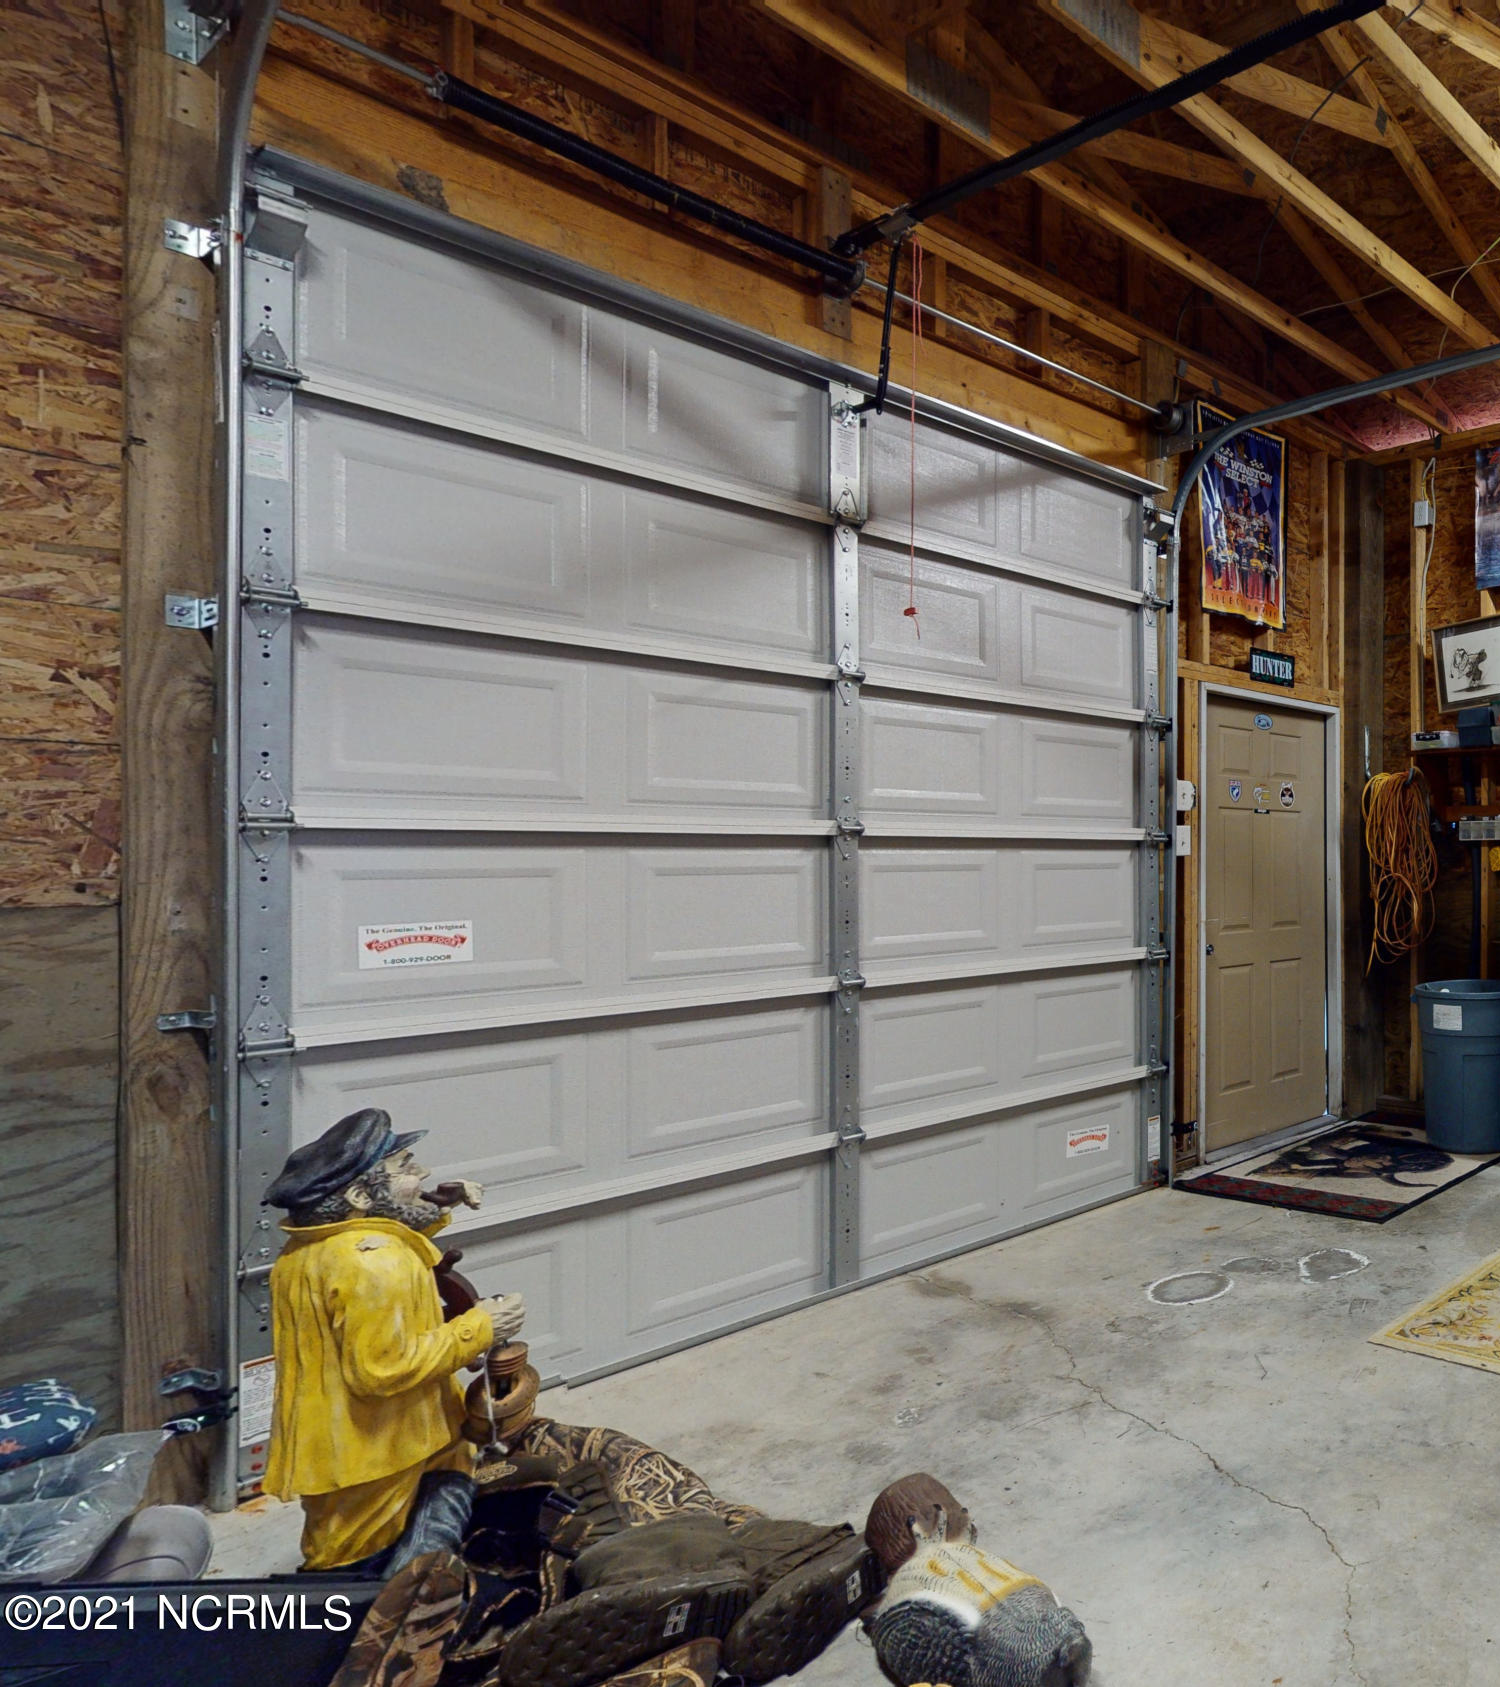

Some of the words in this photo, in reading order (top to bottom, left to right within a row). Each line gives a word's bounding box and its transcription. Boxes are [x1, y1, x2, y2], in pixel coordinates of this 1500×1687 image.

[1225, 468, 1259, 488] SELECT
[1230, 459, 1273, 484] WINSTON
[1252, 654, 1293, 680] HUNTER
[376, 935, 429, 951] OVERHEAD
